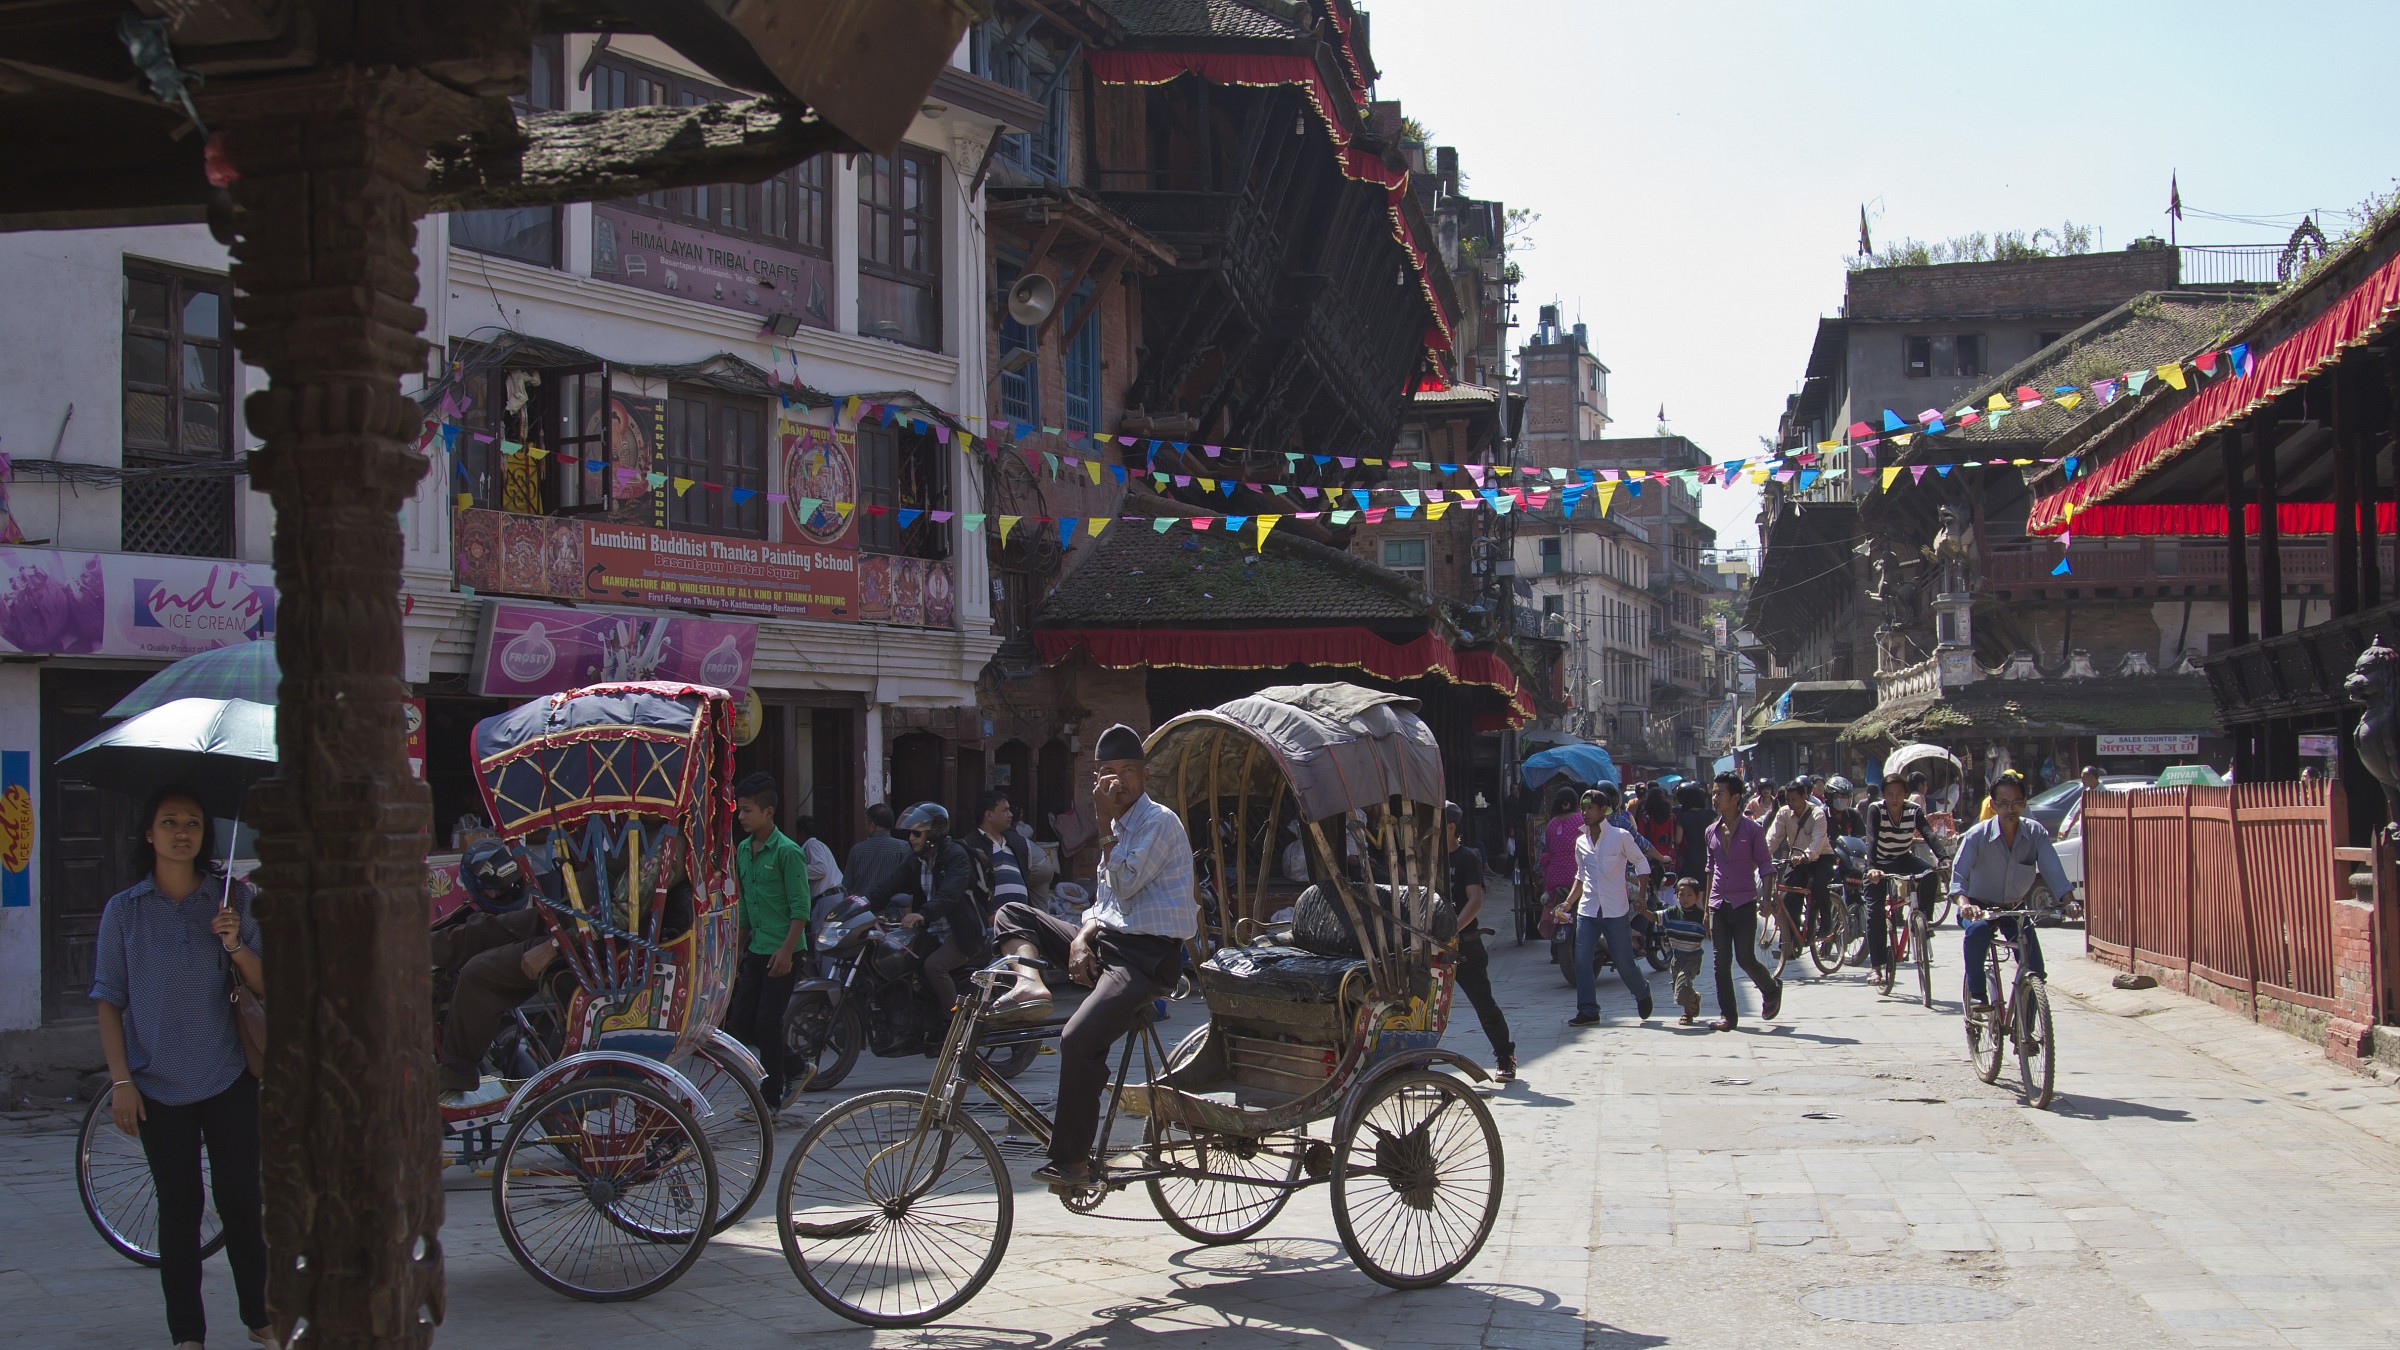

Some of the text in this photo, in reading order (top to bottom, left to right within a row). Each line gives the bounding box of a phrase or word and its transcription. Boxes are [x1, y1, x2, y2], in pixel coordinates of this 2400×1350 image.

[631, 229, 798, 283] HIMALAYAN TRIBAL CRAFTS
[813, 429, 856, 444] MOELA
[655, 405, 664, 527] SHAKYA DDHA
[590, 527, 853, 572] Lumbini Buddhist Thanka Painting School
[654, 554, 724, 574] Basantapur
[726, 562, 765, 576] Darbar
[766, 565, 799, 580] Squar
[144, 564, 264, 618] nd's
[602, 575, 658, 590] MANUFACTURE
[660, 581, 676, 592] AND
[679, 583, 725, 597] WHOLSELLER
[727, 587, 736, 597] OF
[738, 588, 752, 599] ALL
[754, 590, 772, 600] KIND
[774, 592, 782, 601] OF
[784, 592, 813, 603] THANKA
[814, 595, 846, 606] PAINTING
[648, 592, 663, 602] First
[665, 594, 681, 604] Floor
[683, 597, 691, 605] on
[692, 596, 705, 606] The
[706, 597, 720, 608] Way
[721, 598, 729, 608] To
[730, 600, 772, 613] Kasthmandap
[169, 613, 246, 631] ICE CREAM
[140, 643, 145, 651] A
[146, 643, 169, 654] Quality
[171, 645, 196, 653] Product
[508, 652, 549, 666] FROSTY
[706, 662, 738, 675] FROSTY
[2166, 770, 2199, 780] SHIVAM
[20, 797, 31, 861] ICE CREAM
